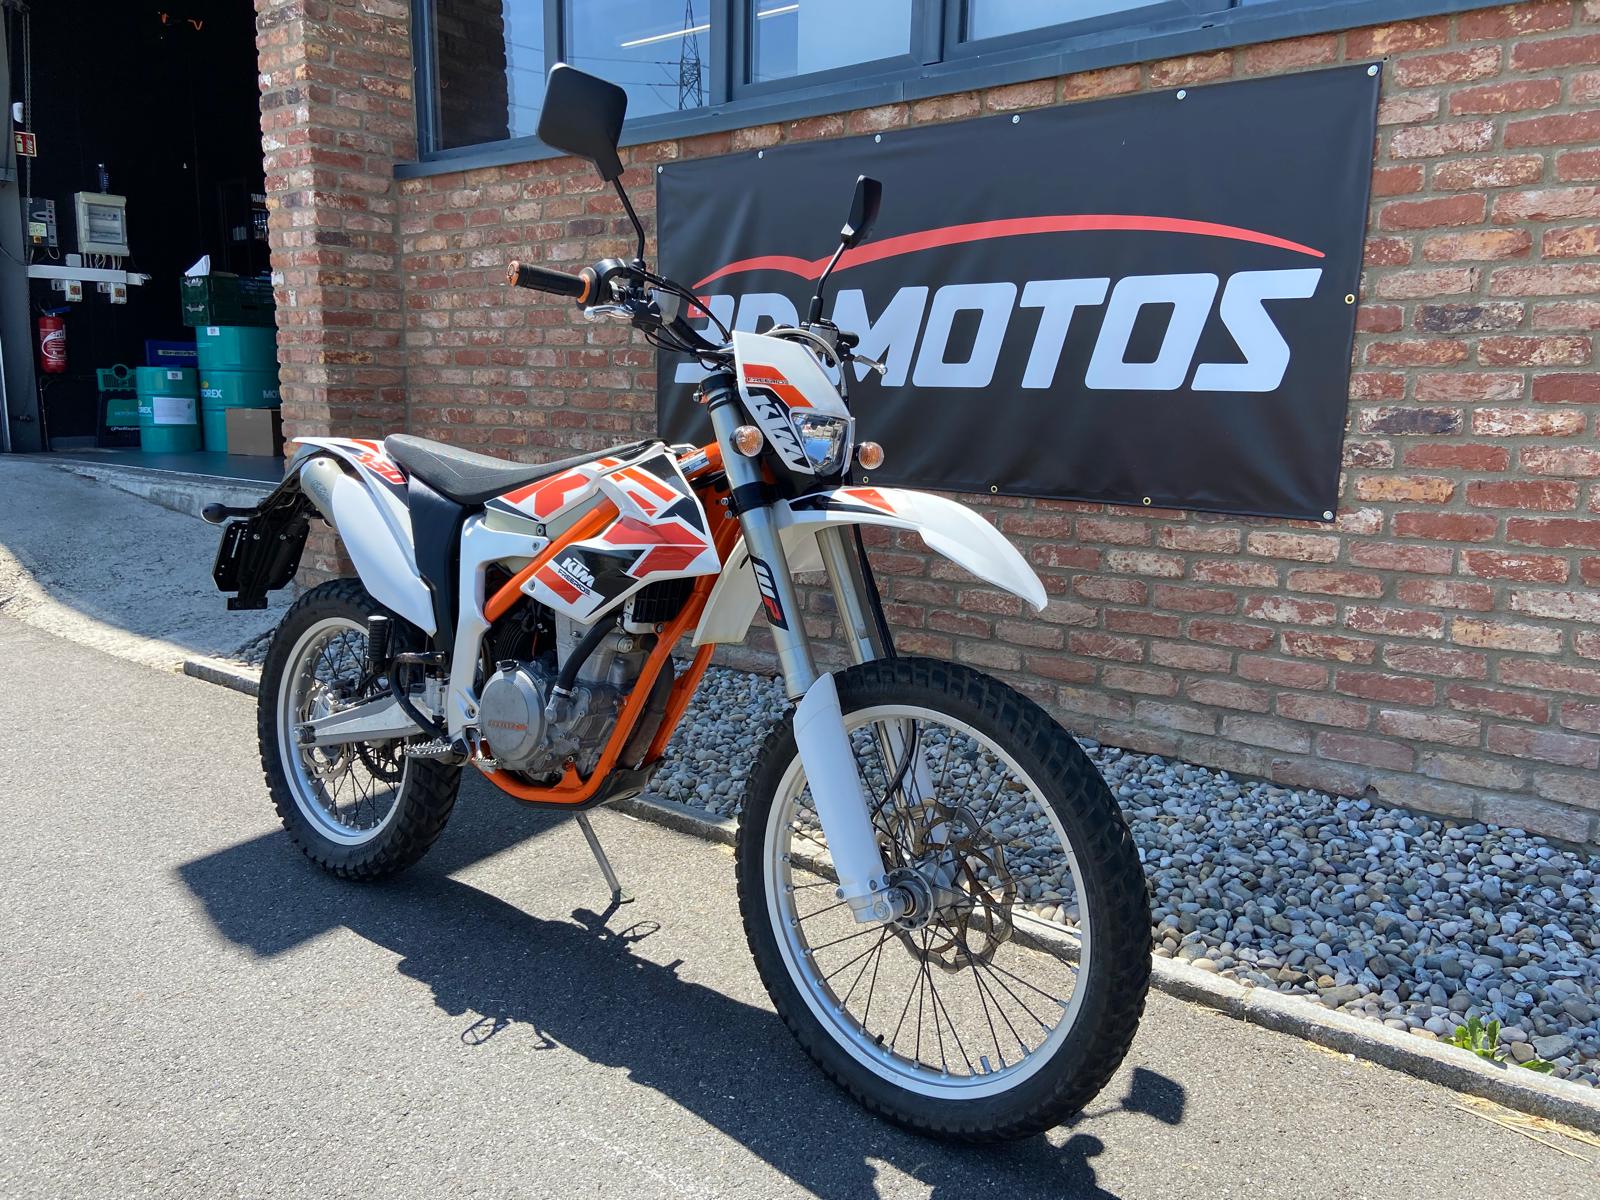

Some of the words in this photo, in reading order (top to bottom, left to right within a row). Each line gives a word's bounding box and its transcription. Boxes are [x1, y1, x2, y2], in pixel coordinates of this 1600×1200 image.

[820, 268, 1322, 391] MOTOS
[746, 391, 812, 472] KTM
[561, 557, 595, 587] KTM
